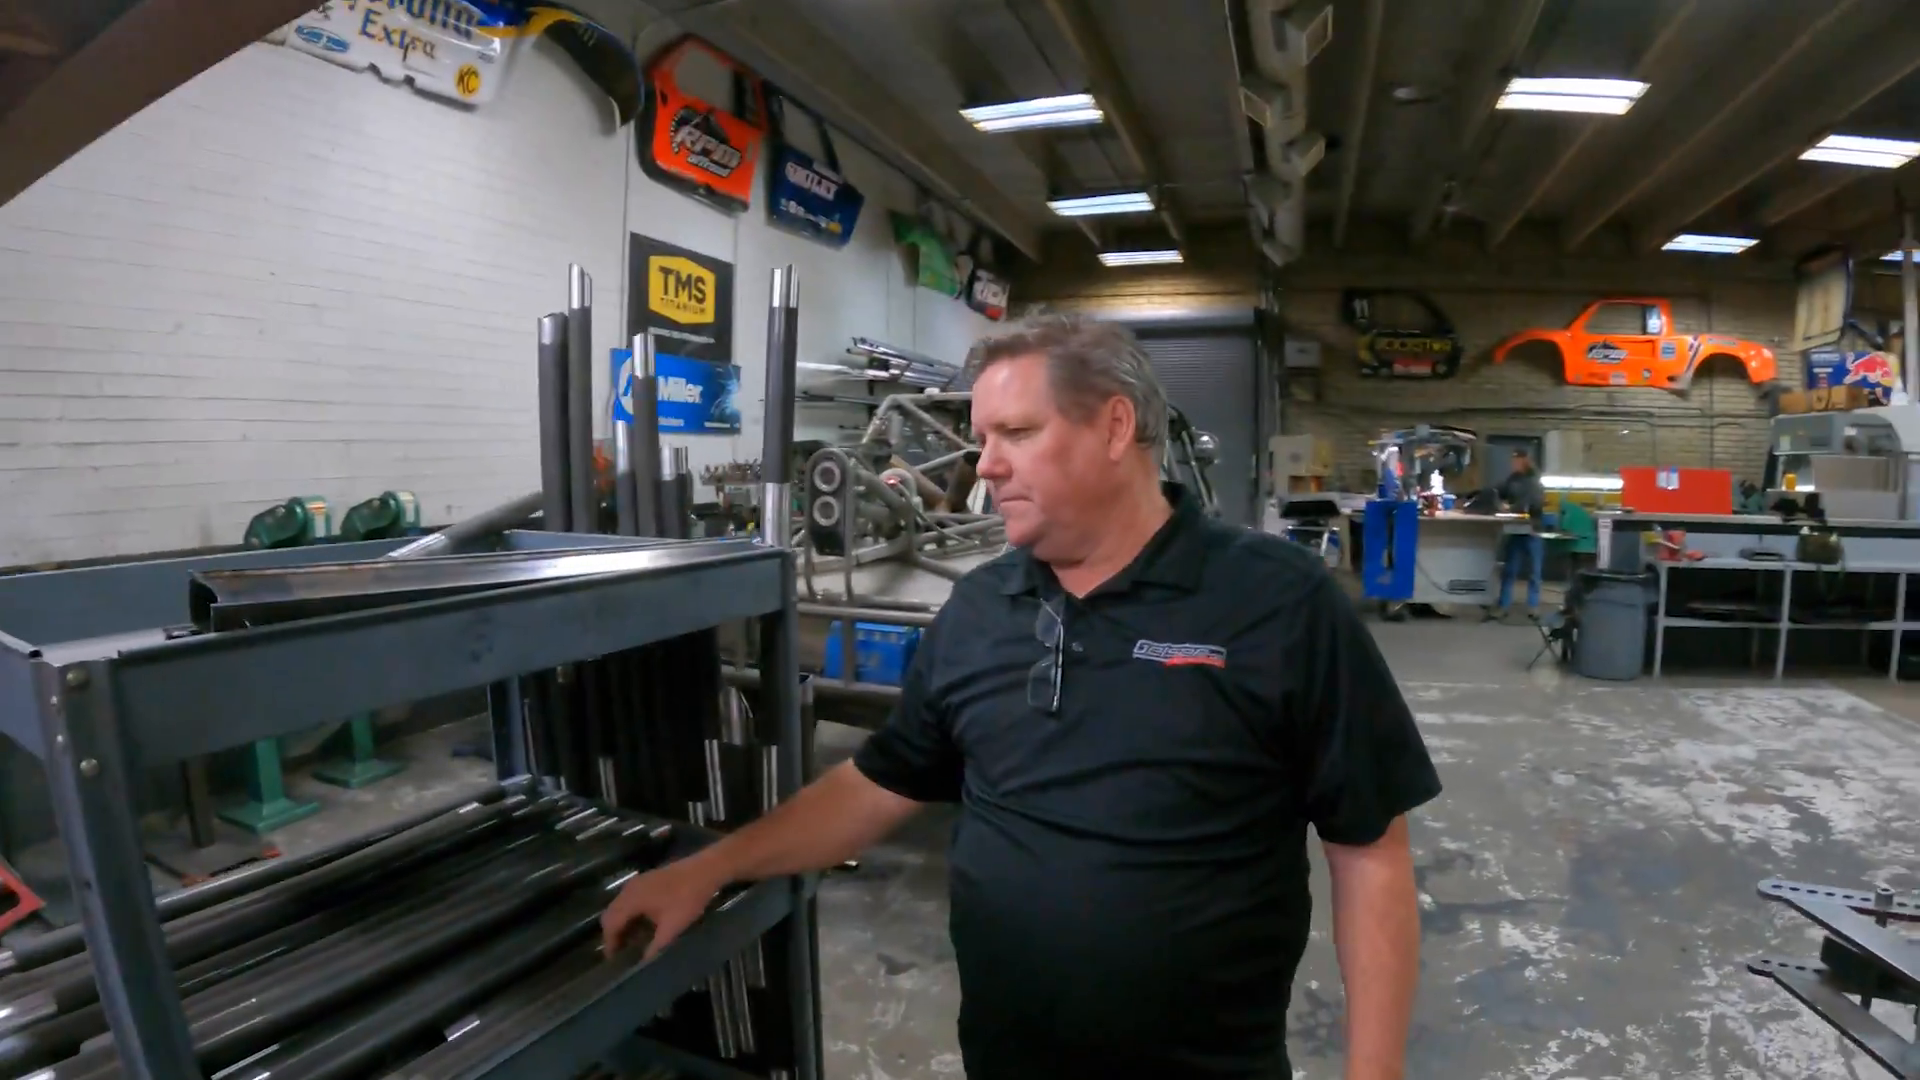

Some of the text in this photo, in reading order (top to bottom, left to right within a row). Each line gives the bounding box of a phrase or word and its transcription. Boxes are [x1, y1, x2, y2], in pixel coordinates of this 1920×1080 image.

[359, 8, 435, 60] Extra
[457, 67, 479, 94] KC
[658, 265, 706, 304] TMS
